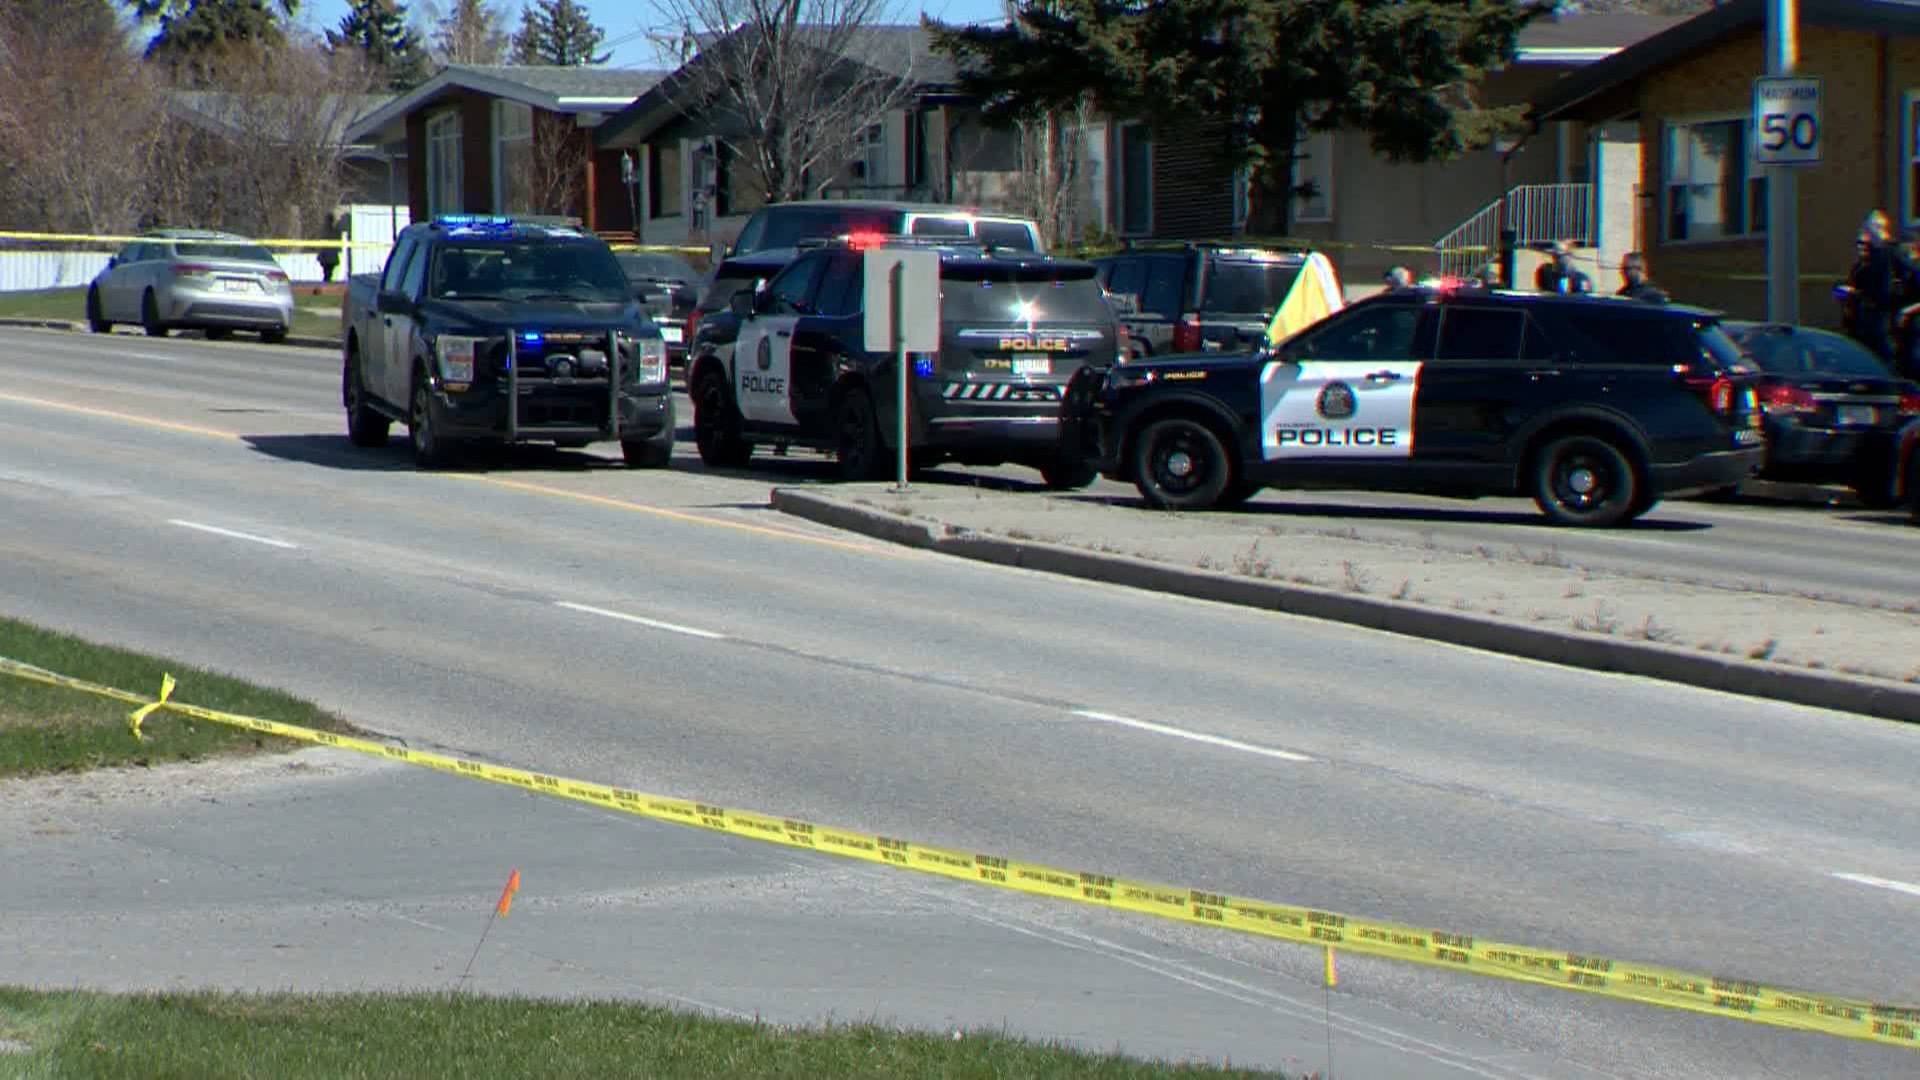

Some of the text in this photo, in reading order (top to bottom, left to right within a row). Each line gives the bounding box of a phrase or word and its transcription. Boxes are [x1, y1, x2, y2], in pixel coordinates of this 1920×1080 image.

[1763, 113, 1816, 150] 50
[999, 339, 1067, 350] POLICE
[742, 375, 785, 394] POLICE
[1277, 429, 1397, 445] POLICE
